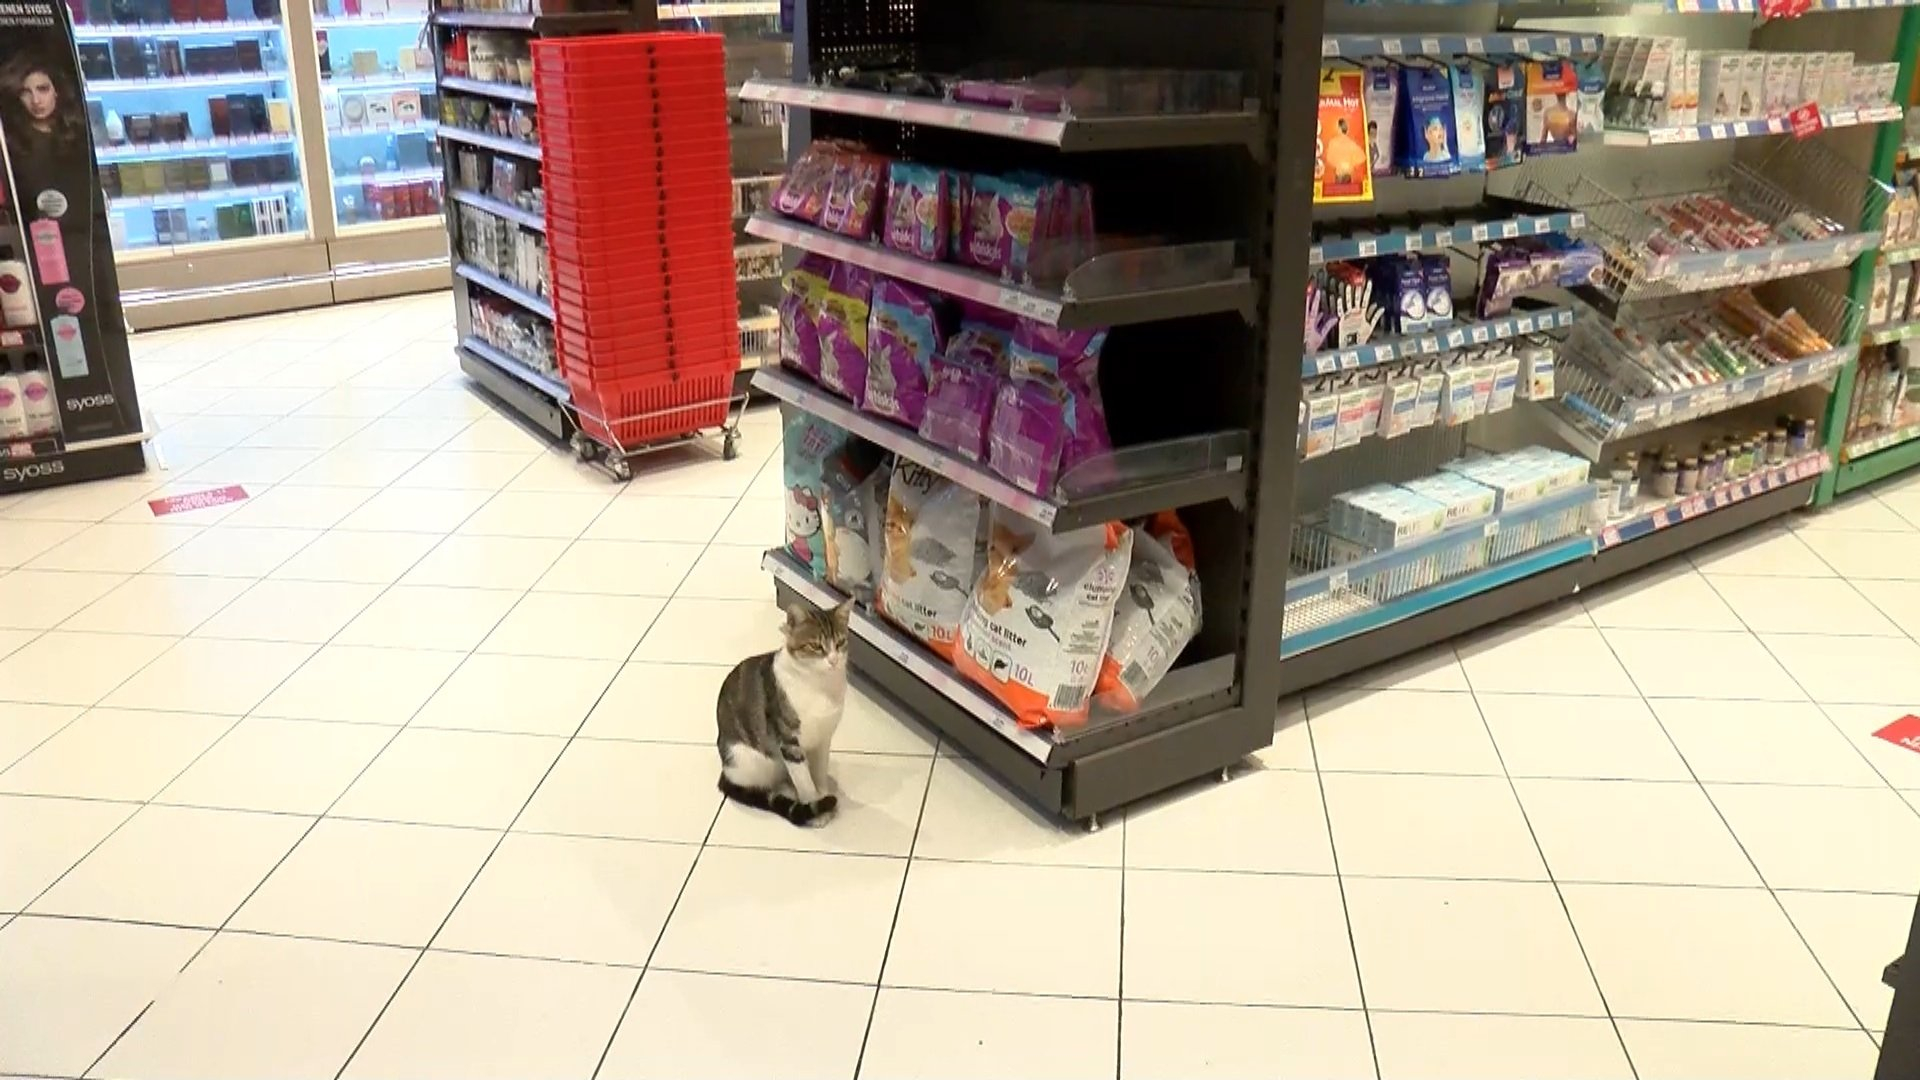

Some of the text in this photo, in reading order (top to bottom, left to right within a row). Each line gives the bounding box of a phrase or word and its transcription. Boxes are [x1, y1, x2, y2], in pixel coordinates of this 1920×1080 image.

[24, 3, 53, 15] SYOSS
[66, 393, 114, 411] syoss
[3, 460, 65, 482] syoss
[893, 455, 943, 496] Kitty
[989, 621, 1003, 637] cat
[1003, 627, 1028, 648] litter
[1014, 663, 1035, 688] 10L
